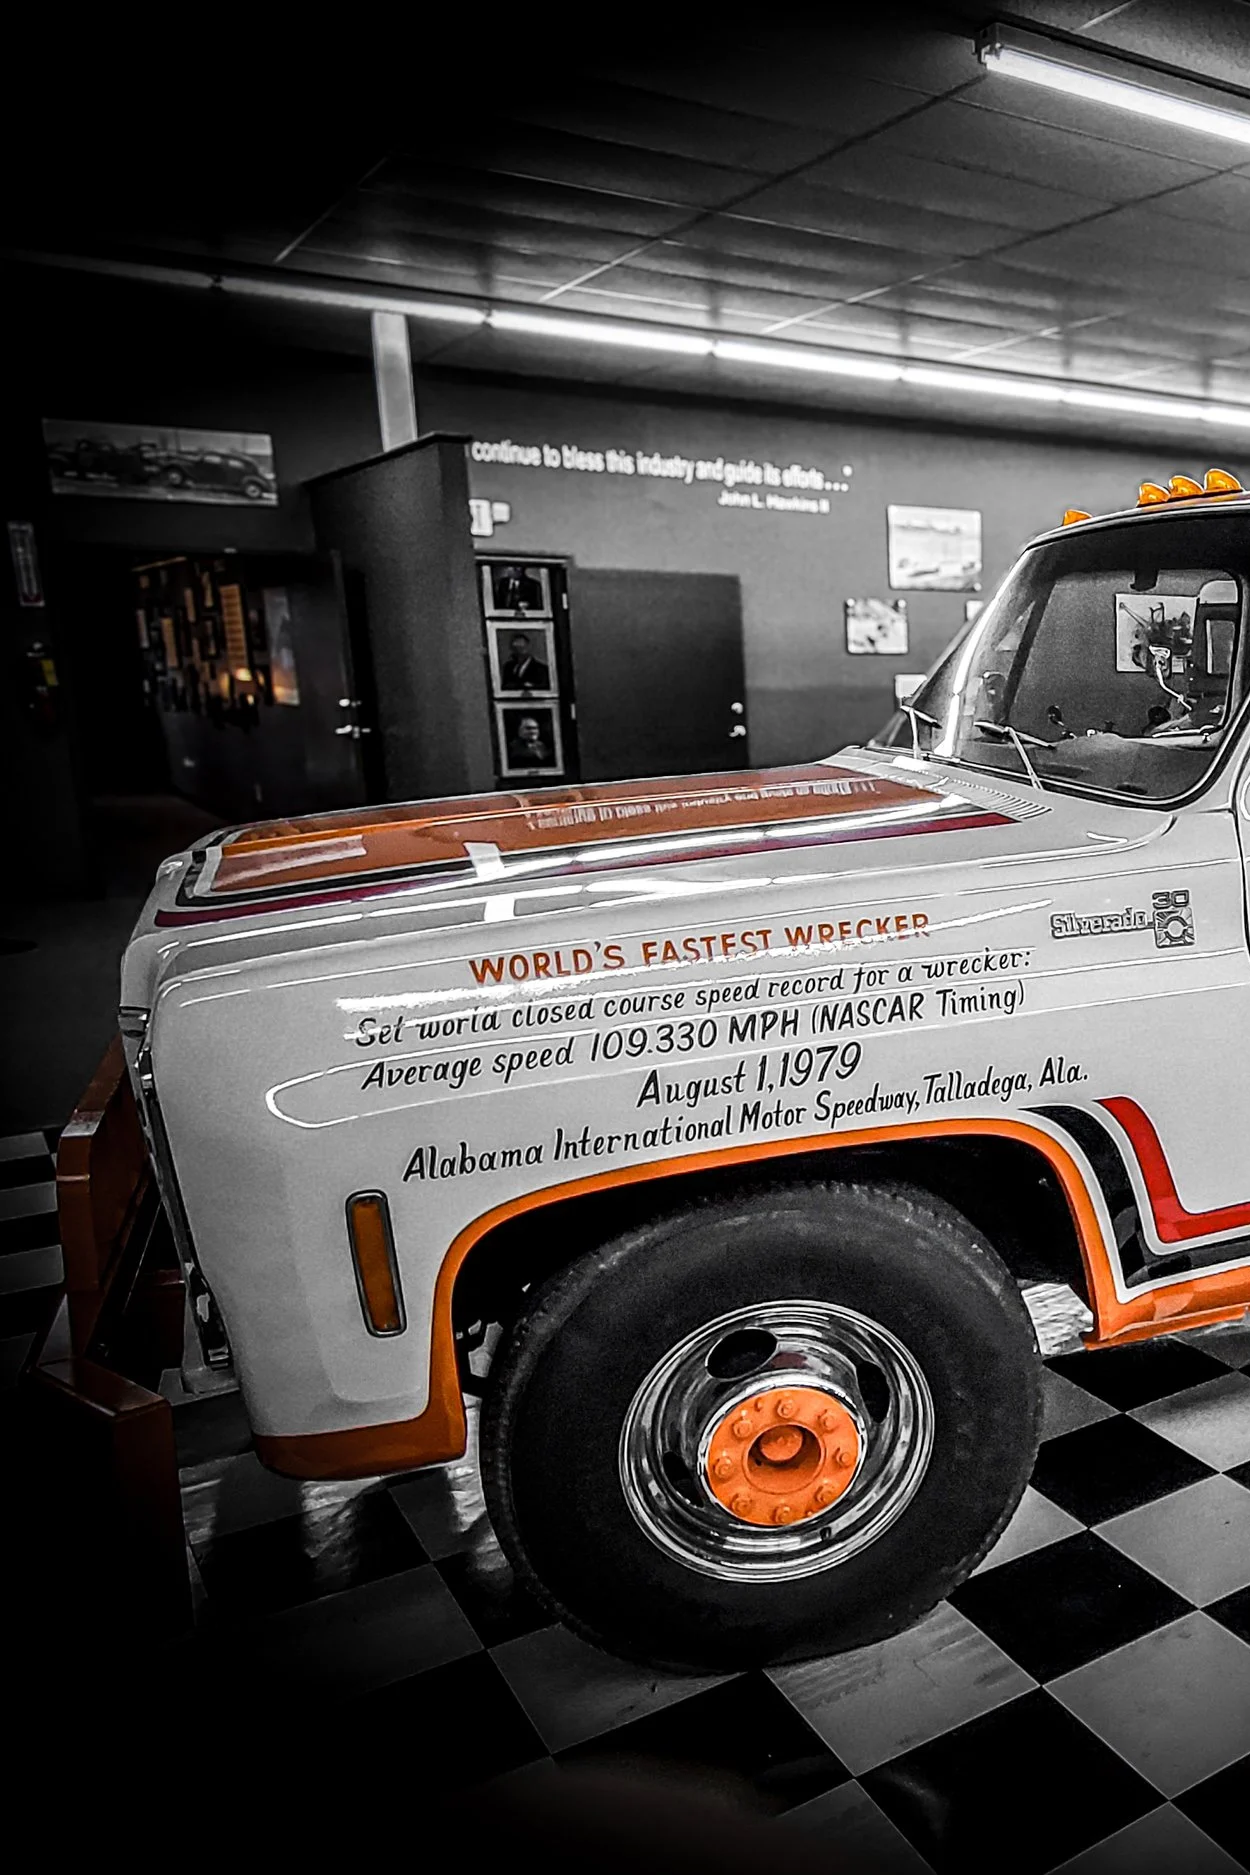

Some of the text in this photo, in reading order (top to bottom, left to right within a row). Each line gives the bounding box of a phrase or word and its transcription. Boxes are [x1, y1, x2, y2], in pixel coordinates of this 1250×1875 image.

[471, 439, 542, 467] continue
[543, 444, 561, 468] to
[562, 444, 605, 472] bless
[605, 449, 635, 475] this
[636, 451, 695, 485] industry
[695, 457, 724, 482] and
[724, 459, 763, 487] guide
[469, 913, 930, 984] WORLD'S FASTEST WRECKER
[1051, 907, 1149, 939] Silverado
[355, 948, 1033, 1046] Set world closed course speed record for a wrecker:
[361, 979, 1027, 1090] Average speed 109.330 MPH (NASCAR Timing)
[402, 1057, 1090, 1183] Alabama International Motor Speedway, Talladega, Ala.
[636, 1069, 746, 1107] August
